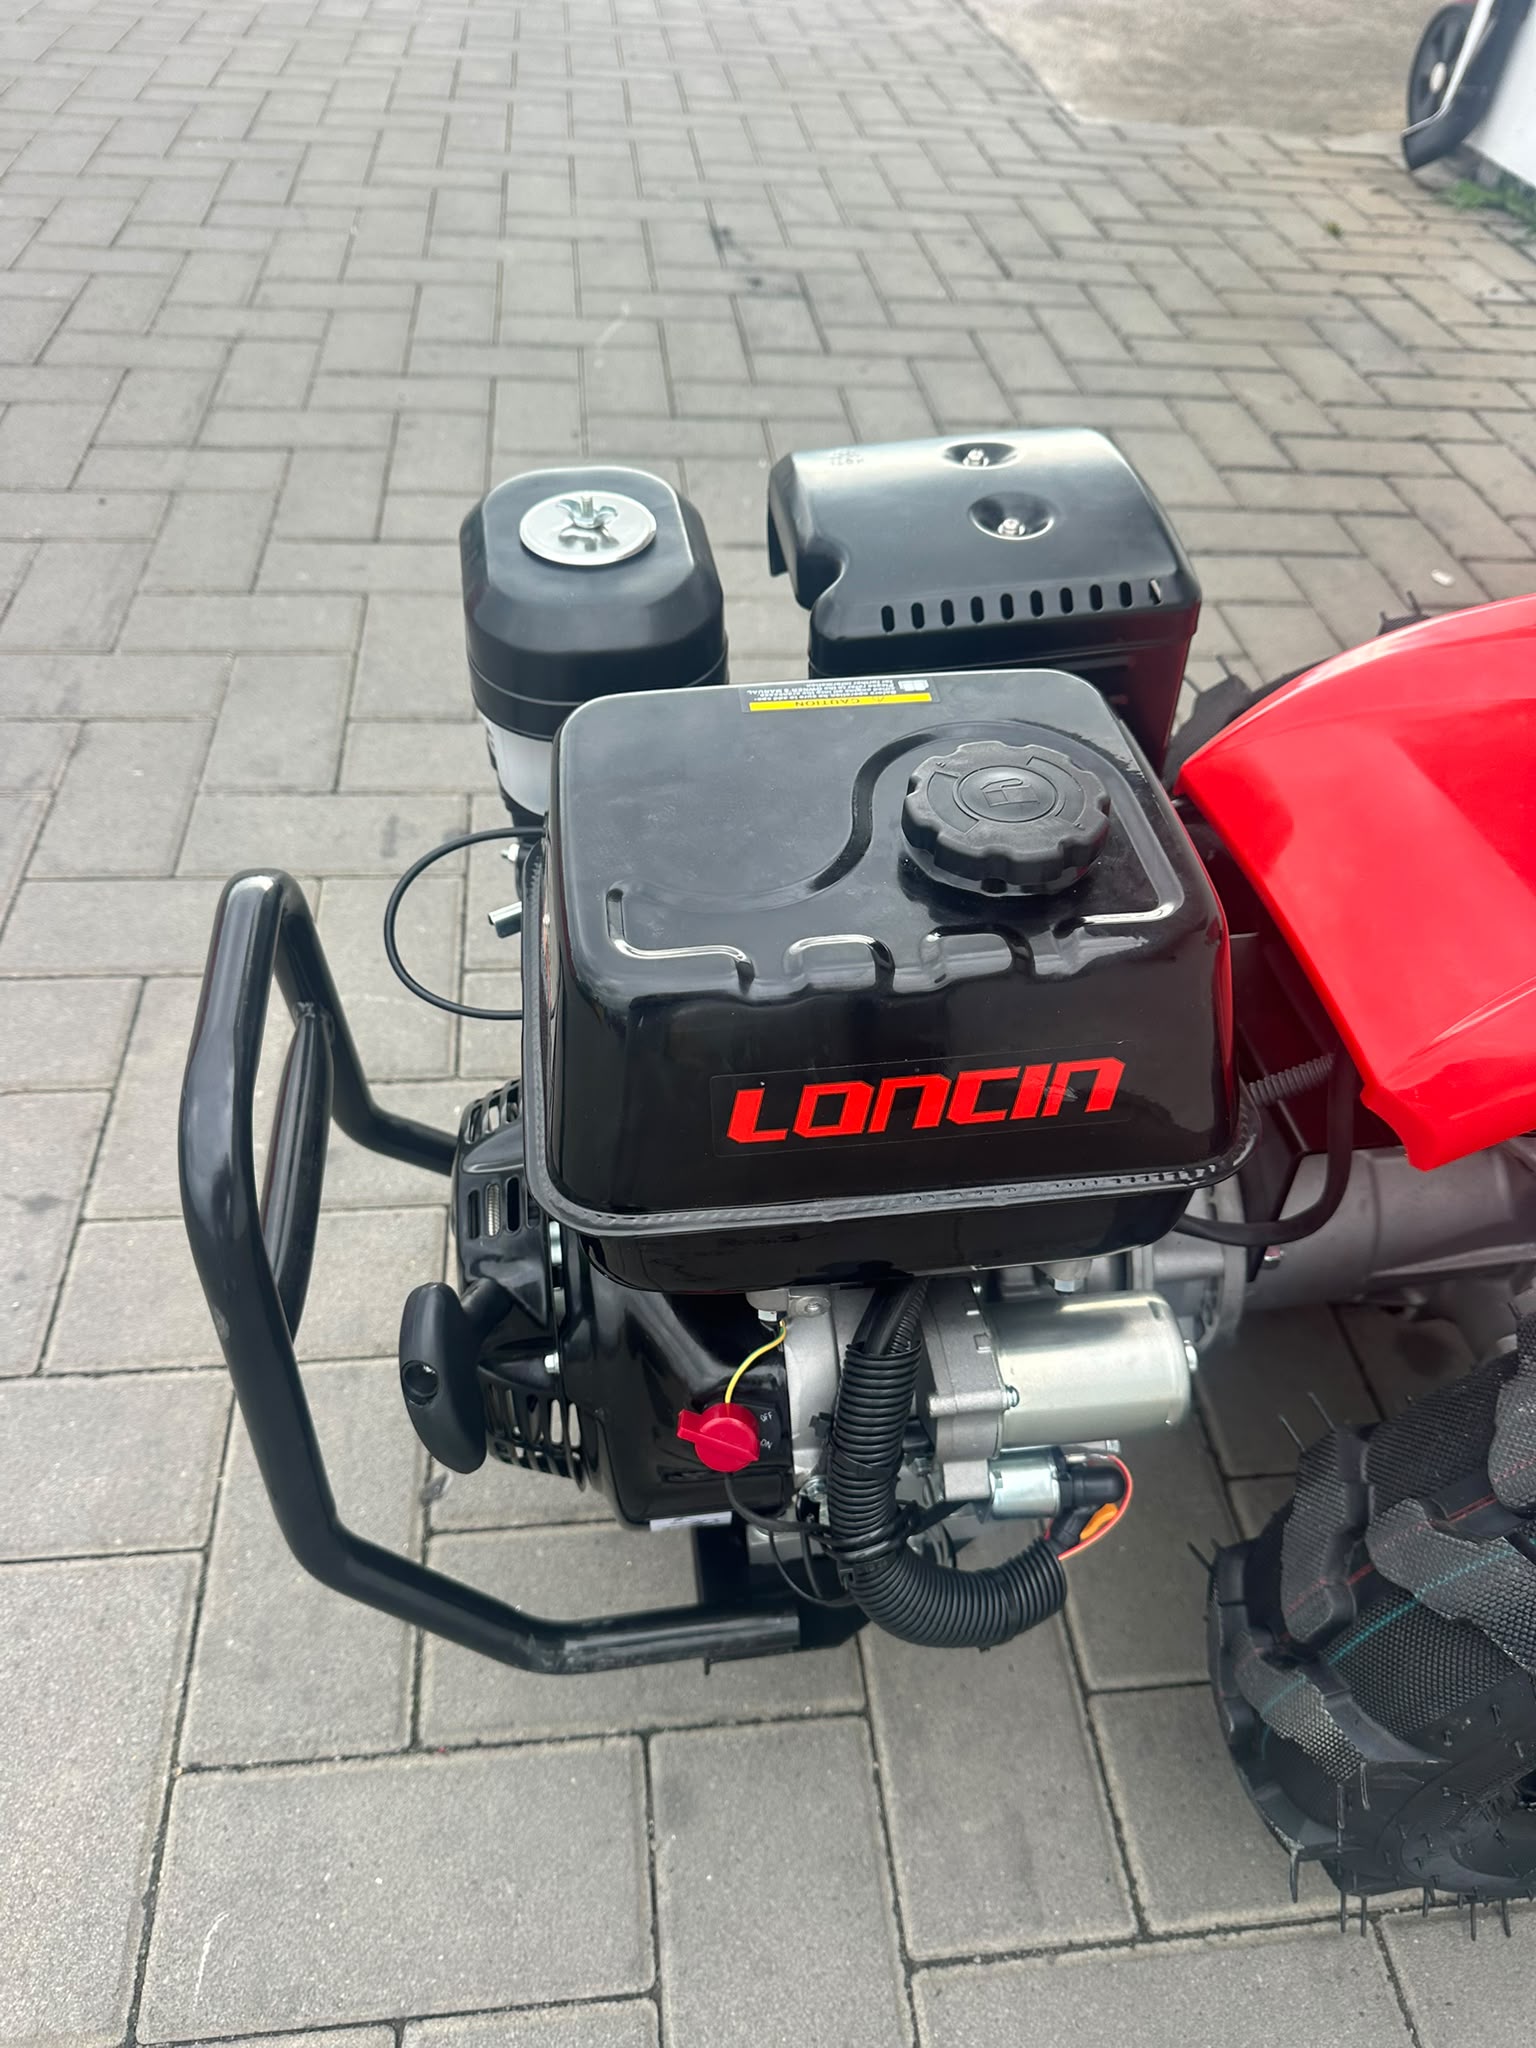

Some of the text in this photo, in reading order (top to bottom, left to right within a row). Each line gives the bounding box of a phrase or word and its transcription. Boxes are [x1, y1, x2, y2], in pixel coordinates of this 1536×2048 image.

[726, 1057, 1126, 1143] LONCIN
[760, 1411, 773, 1422] OFF
[760, 1438, 773, 1450] ON
